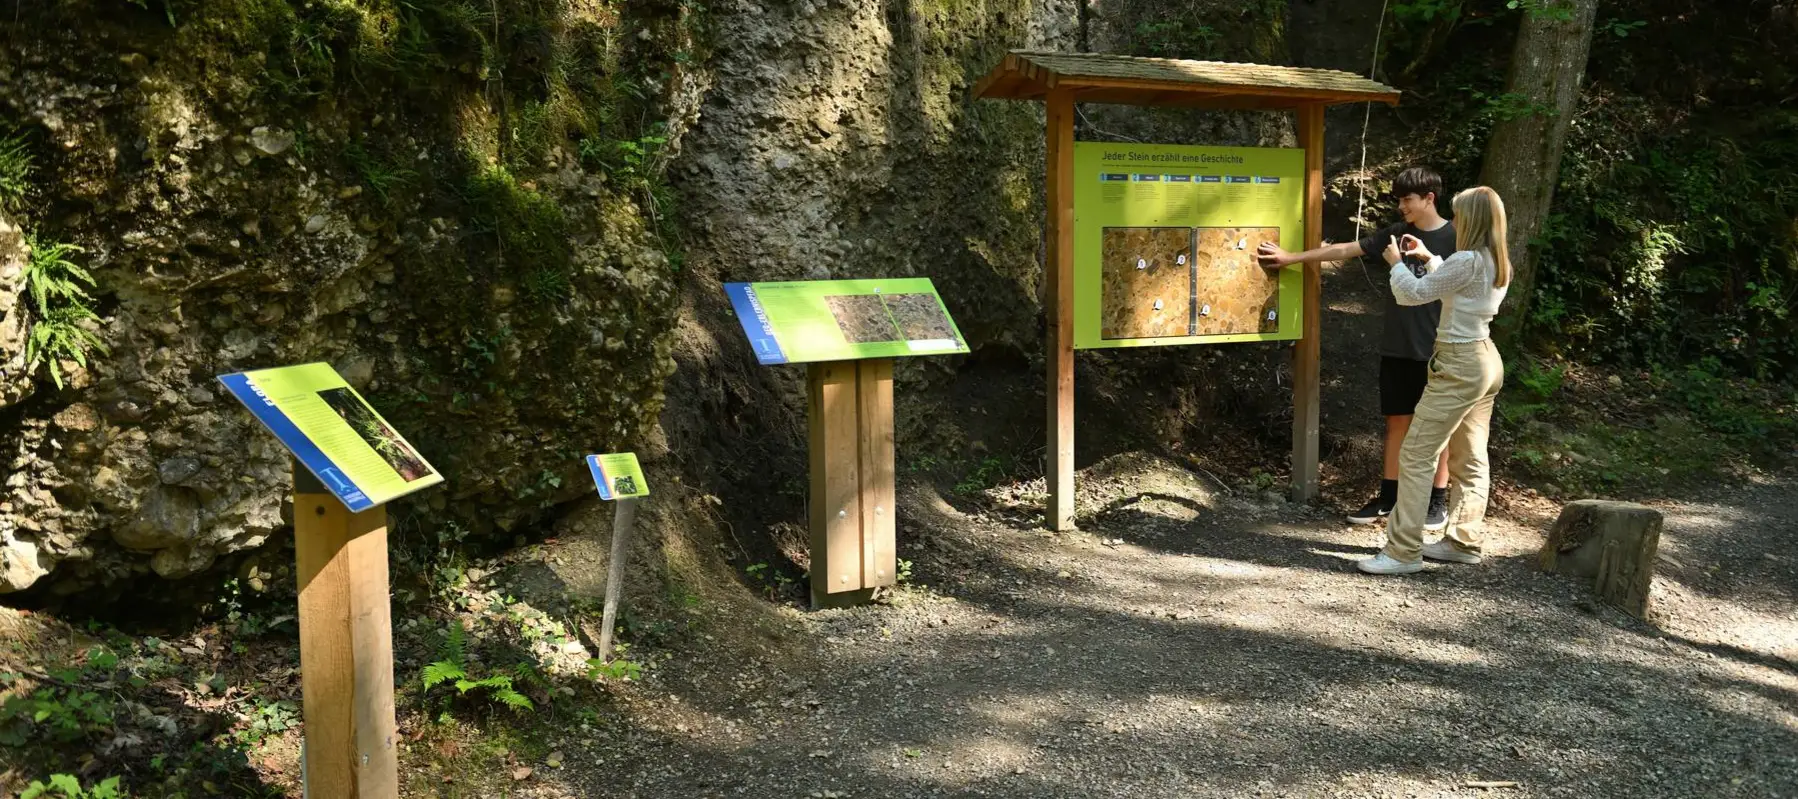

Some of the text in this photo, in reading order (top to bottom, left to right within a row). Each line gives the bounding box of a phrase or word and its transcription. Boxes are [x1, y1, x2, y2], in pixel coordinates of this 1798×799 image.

[1102, 151, 1244, 164] Jeder Stein erzählt eine Geschichte
[245, 378, 276, 407] FLORA
